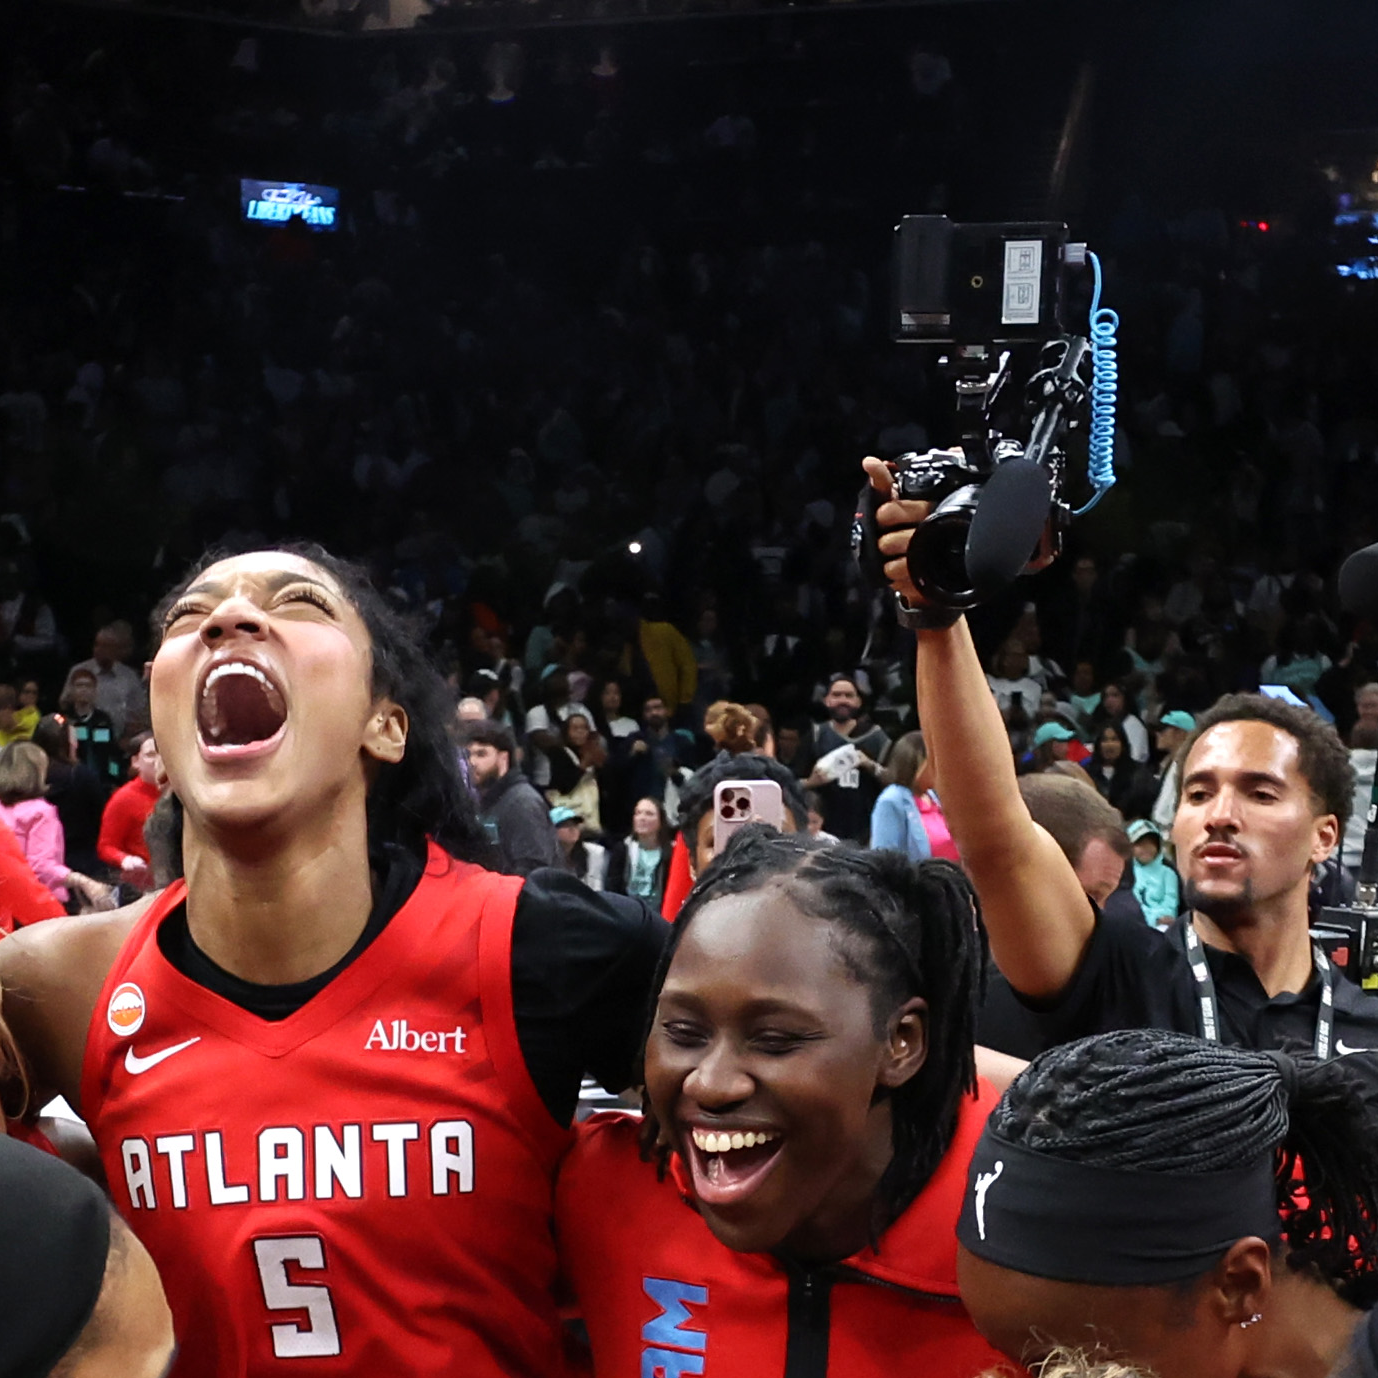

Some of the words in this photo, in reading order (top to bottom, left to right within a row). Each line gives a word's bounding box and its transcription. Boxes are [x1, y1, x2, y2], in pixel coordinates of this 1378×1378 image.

[363, 1019, 467, 1054] Albert
[120, 1119, 474, 1210] ATLANTA
[252, 1235, 342, 1359] 5
